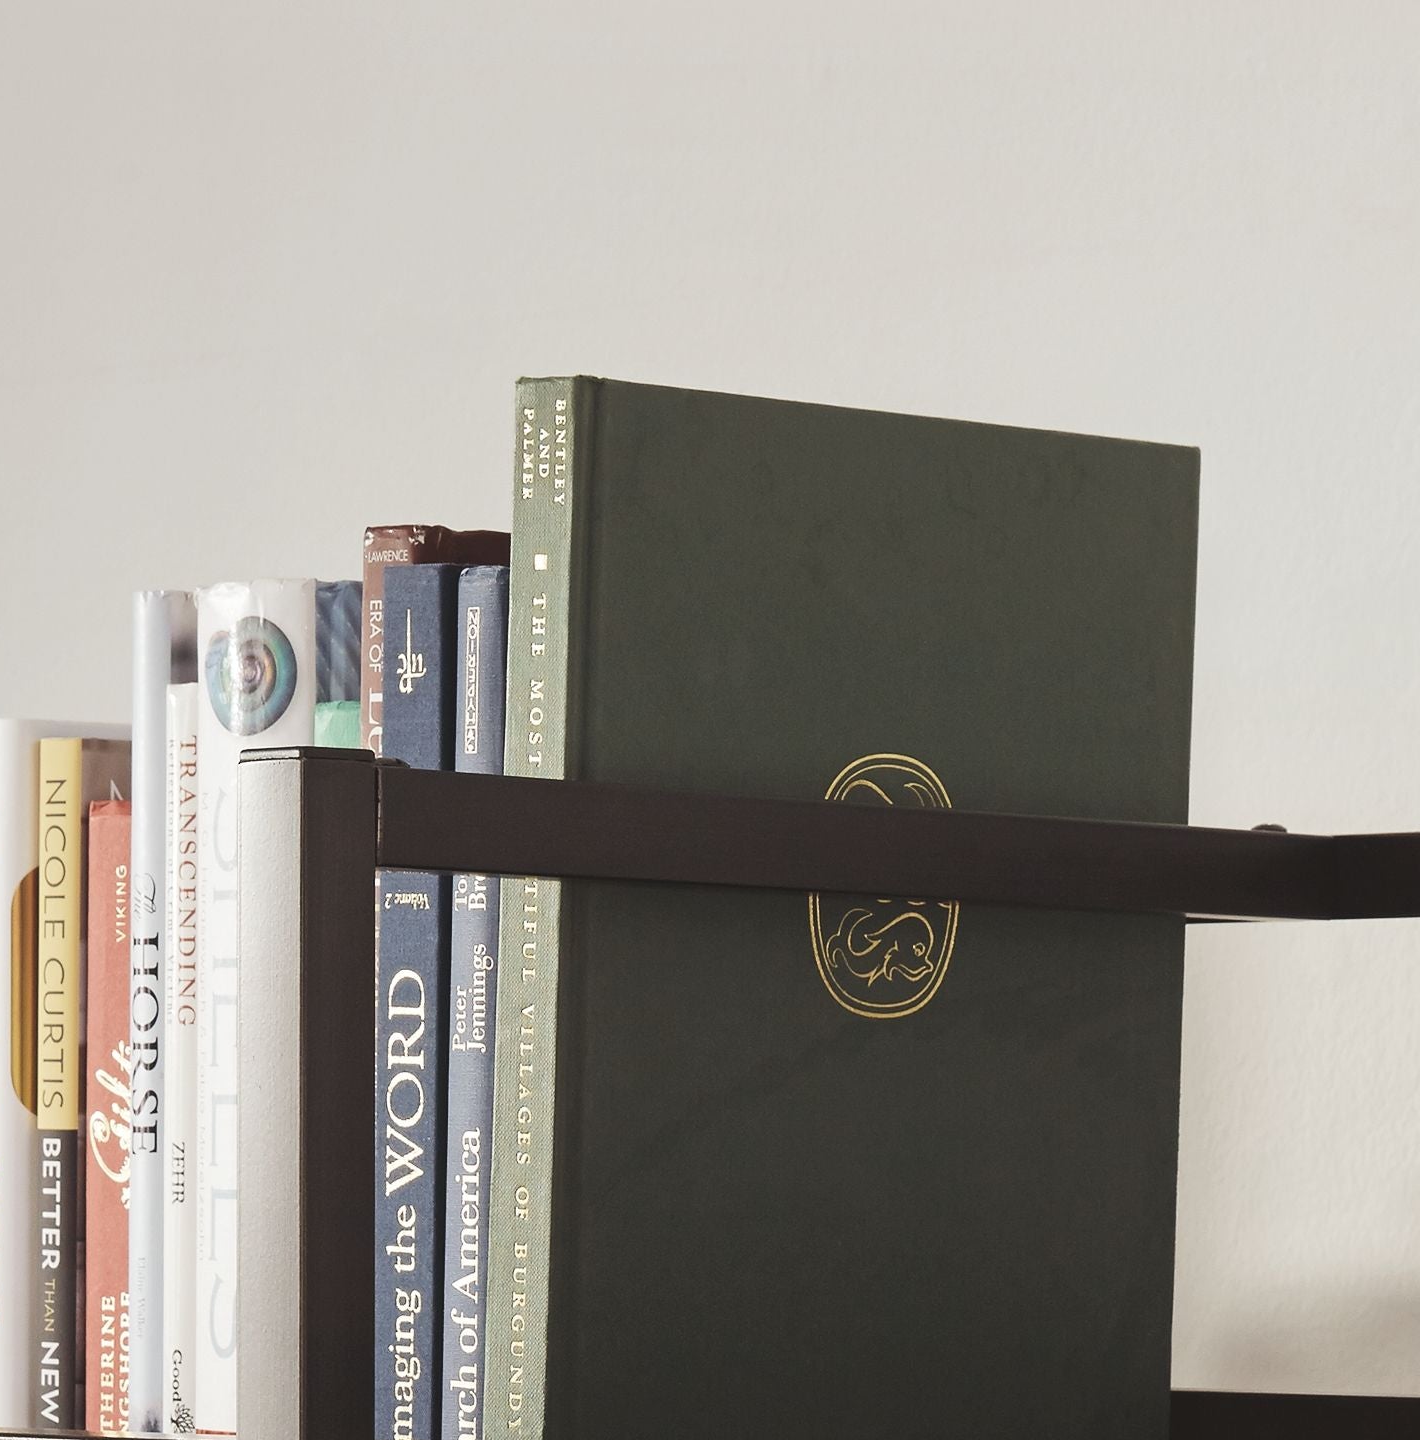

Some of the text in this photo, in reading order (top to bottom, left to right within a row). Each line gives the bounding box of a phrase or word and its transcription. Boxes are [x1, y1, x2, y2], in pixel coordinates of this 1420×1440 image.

[522, 407, 534, 501] PALMER
[538, 427, 549, 479] AND
[554, 398, 567, 506] BENTLEY
[367, 549, 409, 563] LAWRENCE
[368, 644, 382, 673] OF
[369, 599, 383, 638] ERA
[115, 864, 128, 943] VIKING
[384, 891, 393, 910] 2
[454, 874, 468, 912] To
[41, 779, 68, 1109] NICOLE CURTIS
[131, 872, 159, 1155] The HORSE
[452, 985, 467, 1052] Peter
[467, 943, 494, 1053] Jennings
[506, 593, 547, 1437] THE MOST TIFUL VILLAGES OF BURGUNDY
[171, 734, 198, 1402] TRANSCENDING ZEHR Good
[386, 967, 426, 1198] WORD
[385, 1204, 417, 1273] the
[452, 1127, 482, 1304] America
[39, 1137, 61, 1424] BETTER THAN NEW
[450, 1308, 479, 1354] of
